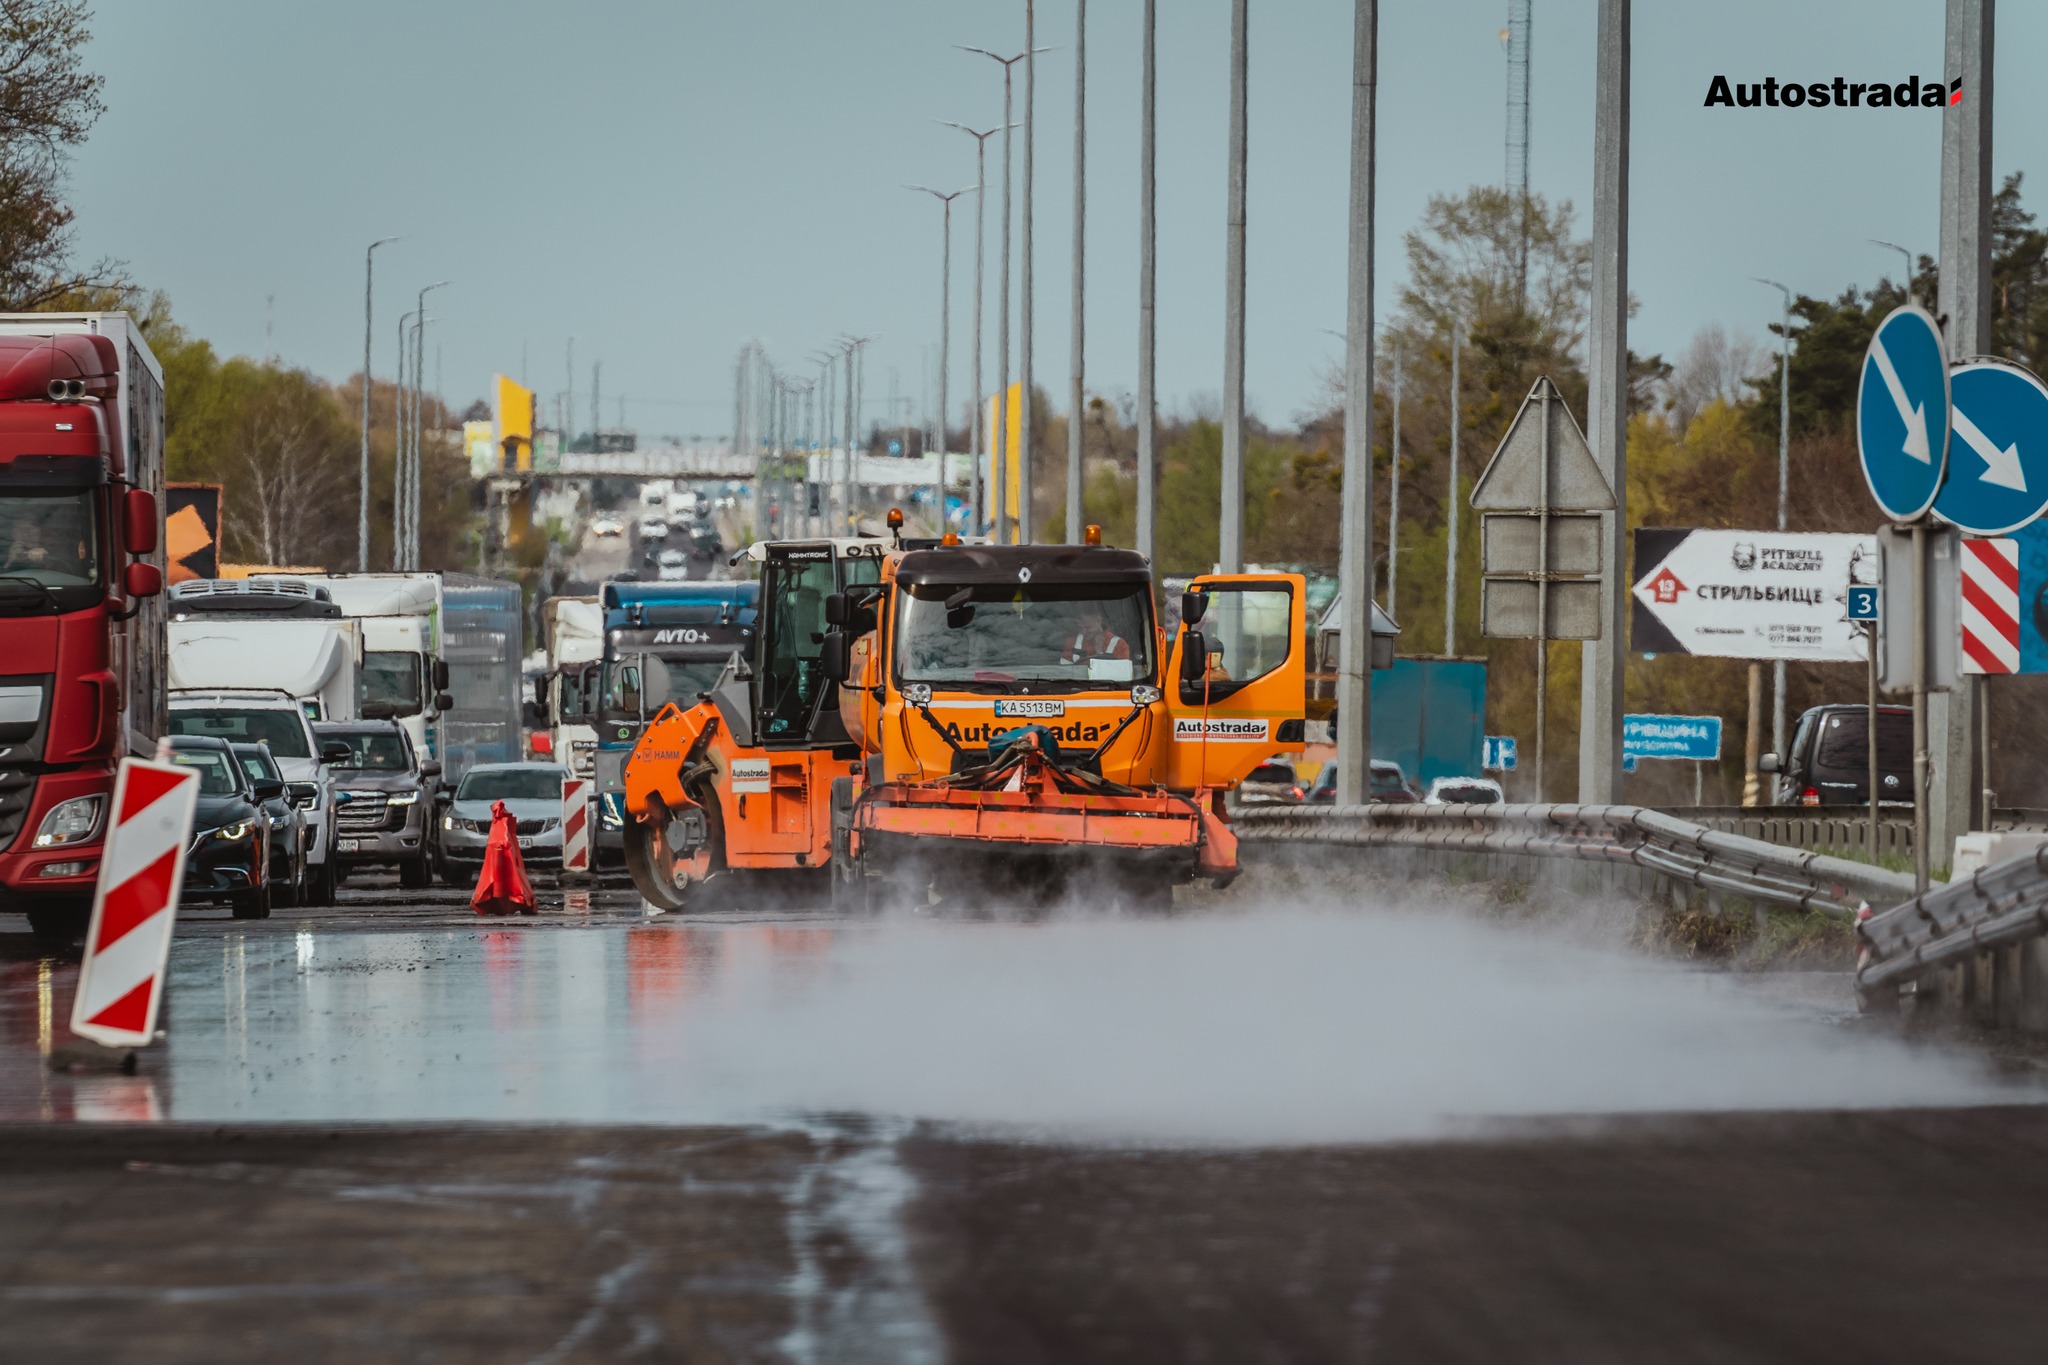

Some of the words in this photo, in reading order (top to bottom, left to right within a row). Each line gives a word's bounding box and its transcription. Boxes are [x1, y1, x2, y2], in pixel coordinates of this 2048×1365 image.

[1761, 548, 1823, 561] PITBULL
[1761, 561, 1822, 571] ACADEMY
[1696, 585, 1823, 605] СТРІЛЬБИЩЕ
[1176, 721, 1260, 733] Autostrada
[654, 751, 681, 760] HAMM
[732, 769, 770, 777] Autostrada
